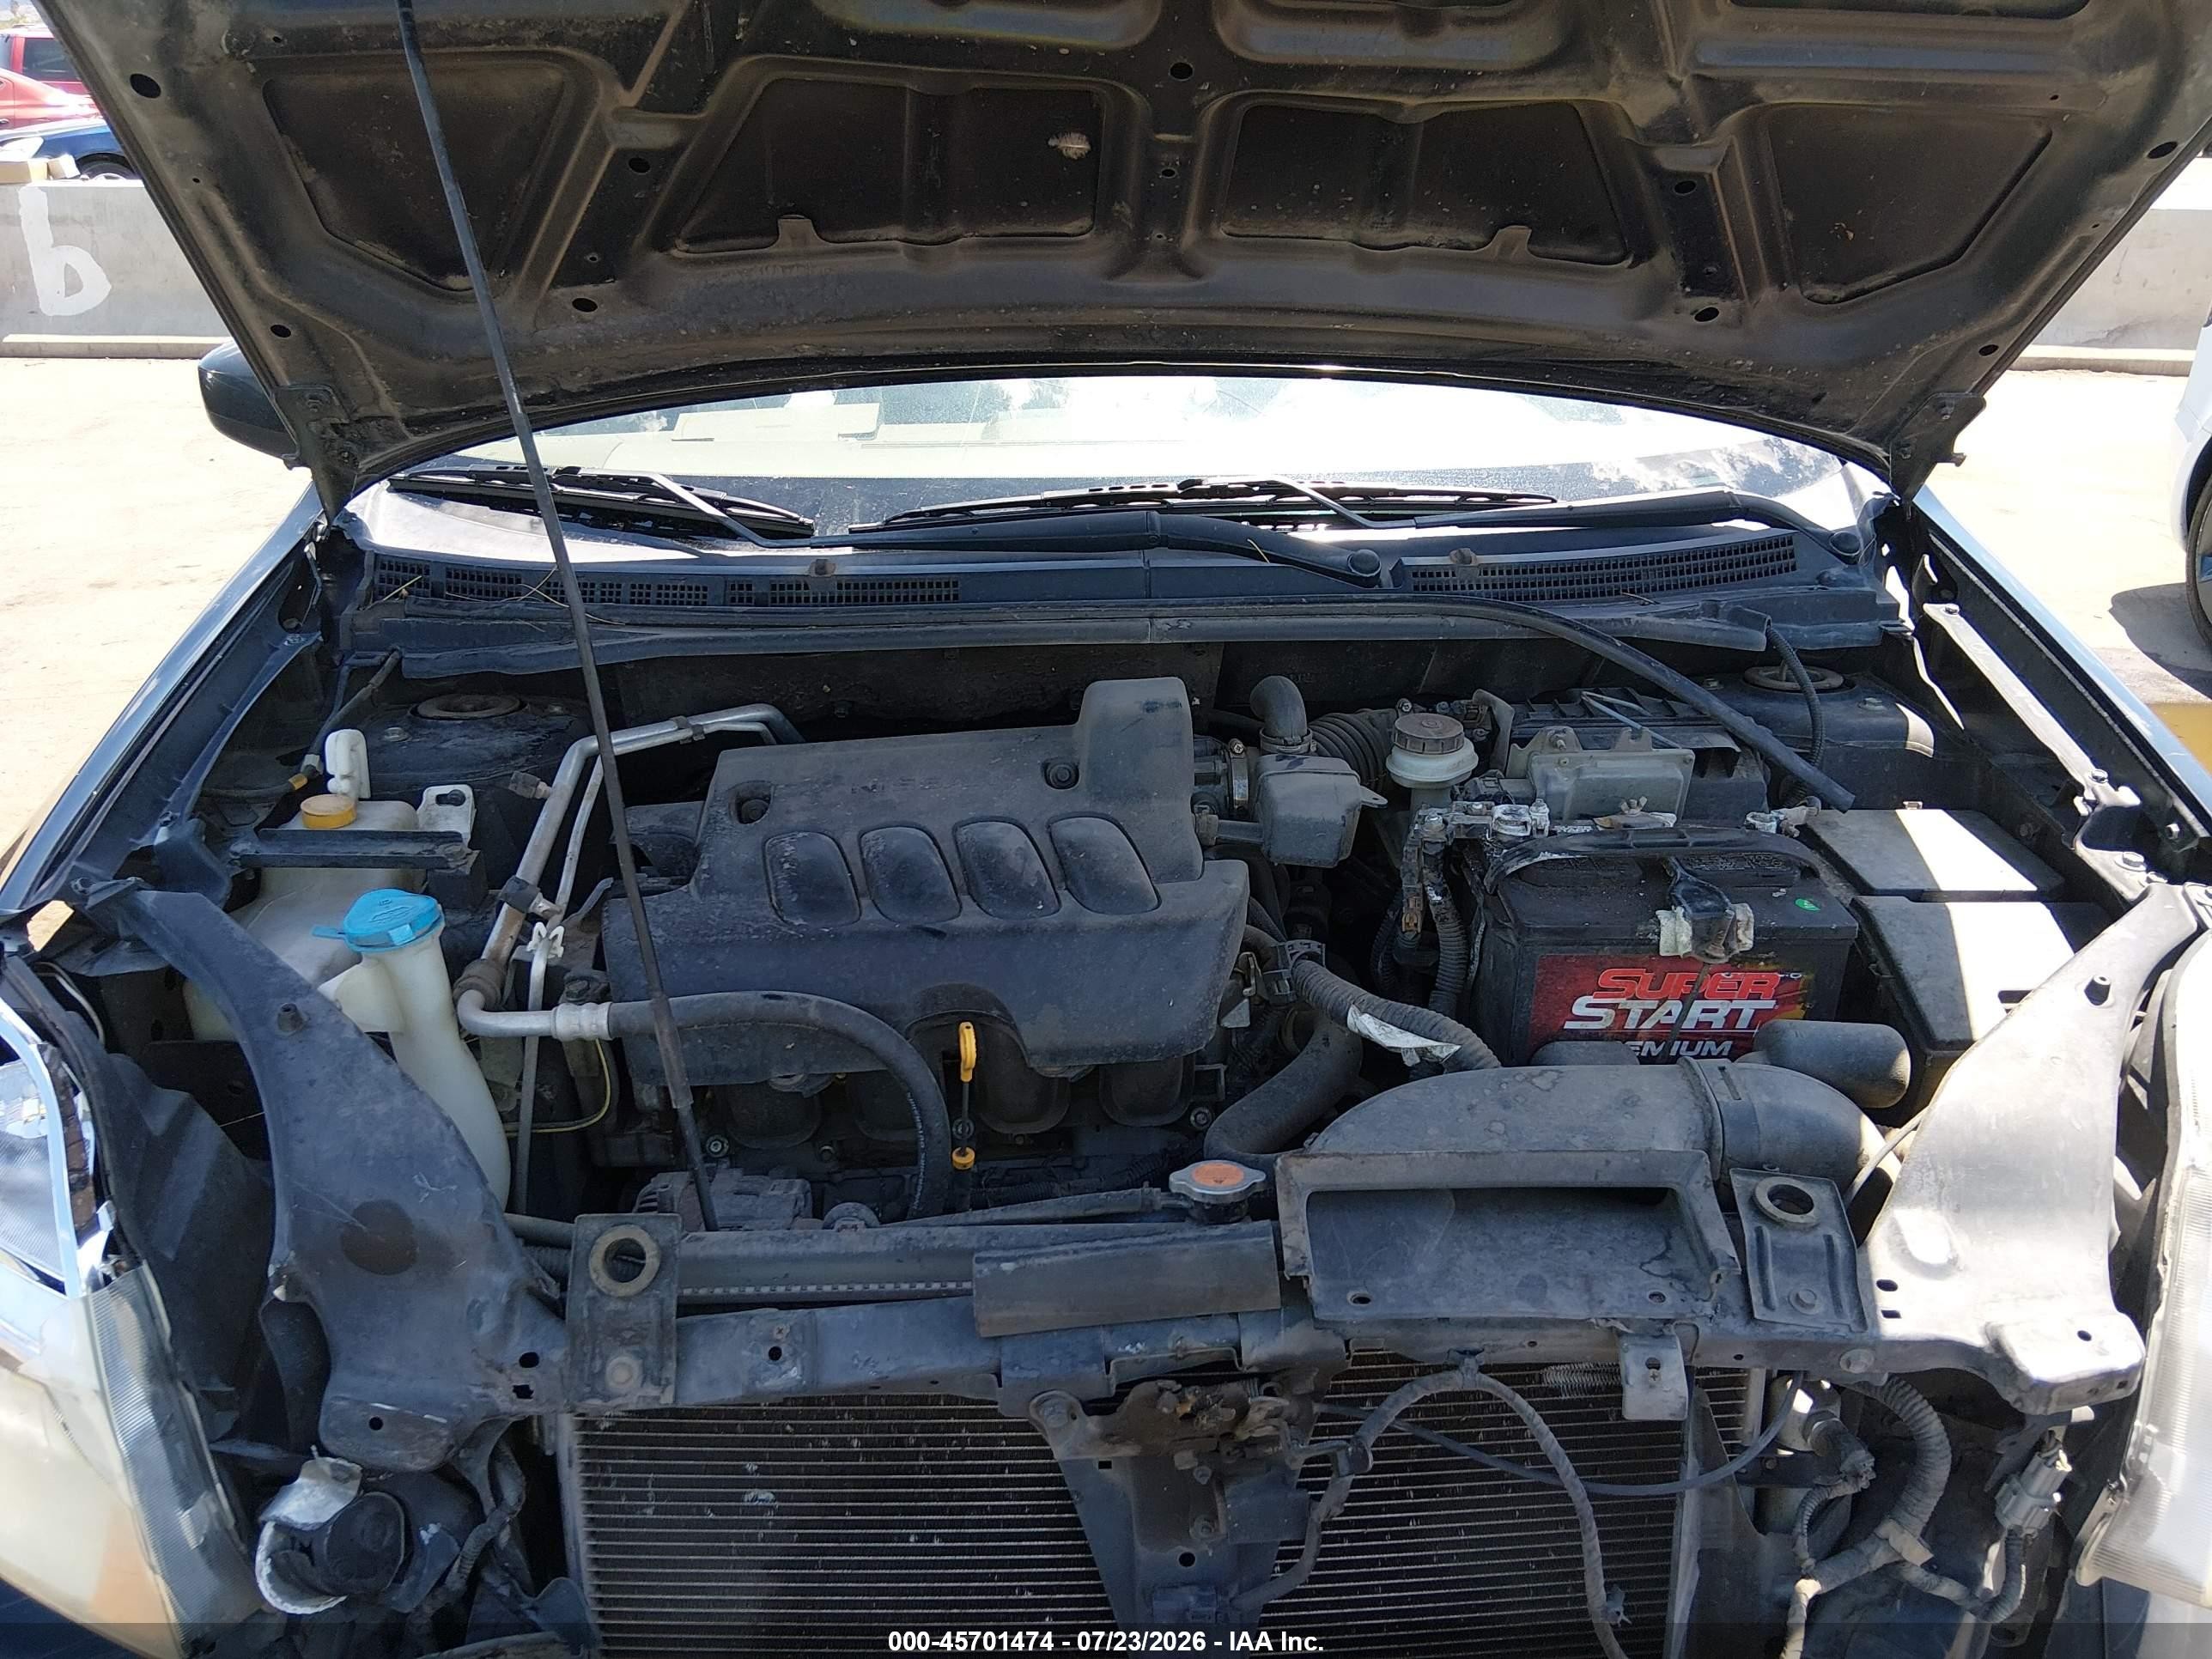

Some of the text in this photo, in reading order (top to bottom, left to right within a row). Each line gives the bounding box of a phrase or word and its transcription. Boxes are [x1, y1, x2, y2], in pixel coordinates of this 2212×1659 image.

[1593, 968, 1782, 1000] SUPER
[1564, 995, 1777, 1030] START
[1629, 1040, 1733, 1056] EMIUM
